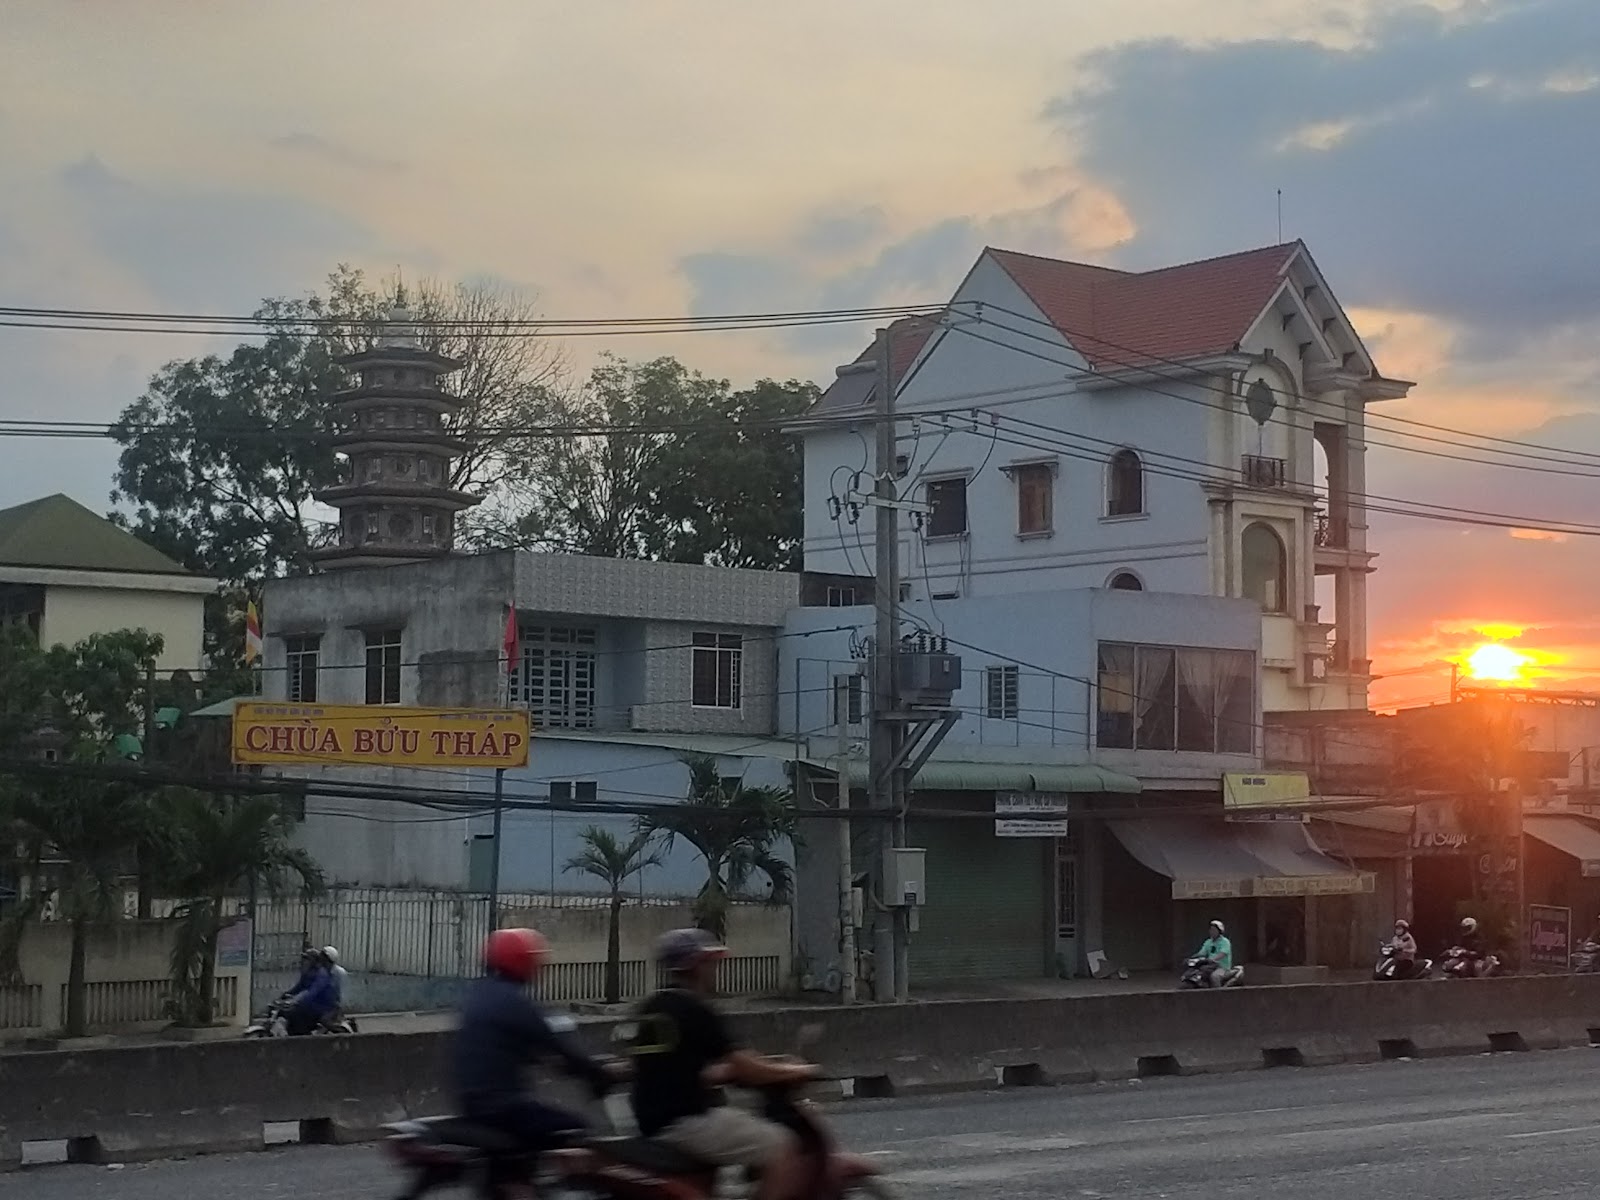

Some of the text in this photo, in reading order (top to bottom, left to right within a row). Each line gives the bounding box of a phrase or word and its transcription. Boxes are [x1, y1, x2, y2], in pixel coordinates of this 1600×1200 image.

[246, 717, 522, 756] CHÙA BỬU THÁP
